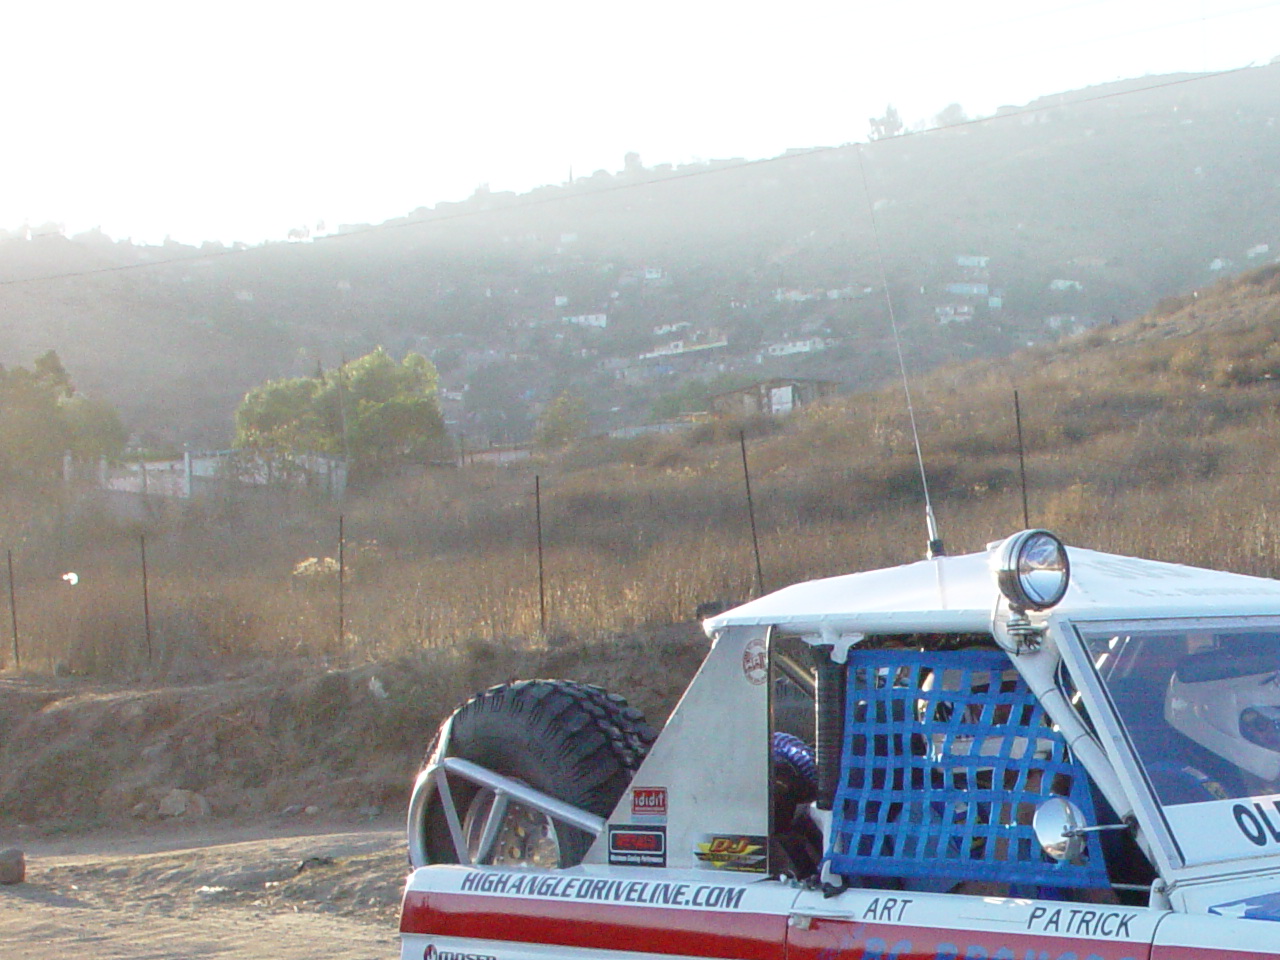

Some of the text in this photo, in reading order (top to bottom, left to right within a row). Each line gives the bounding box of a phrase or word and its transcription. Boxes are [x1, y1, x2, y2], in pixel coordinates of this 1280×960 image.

[461, 871, 747, 909] HIGHANGLEDRIVELINE.COM
[863, 898, 1138, 938] ART PATRICK
